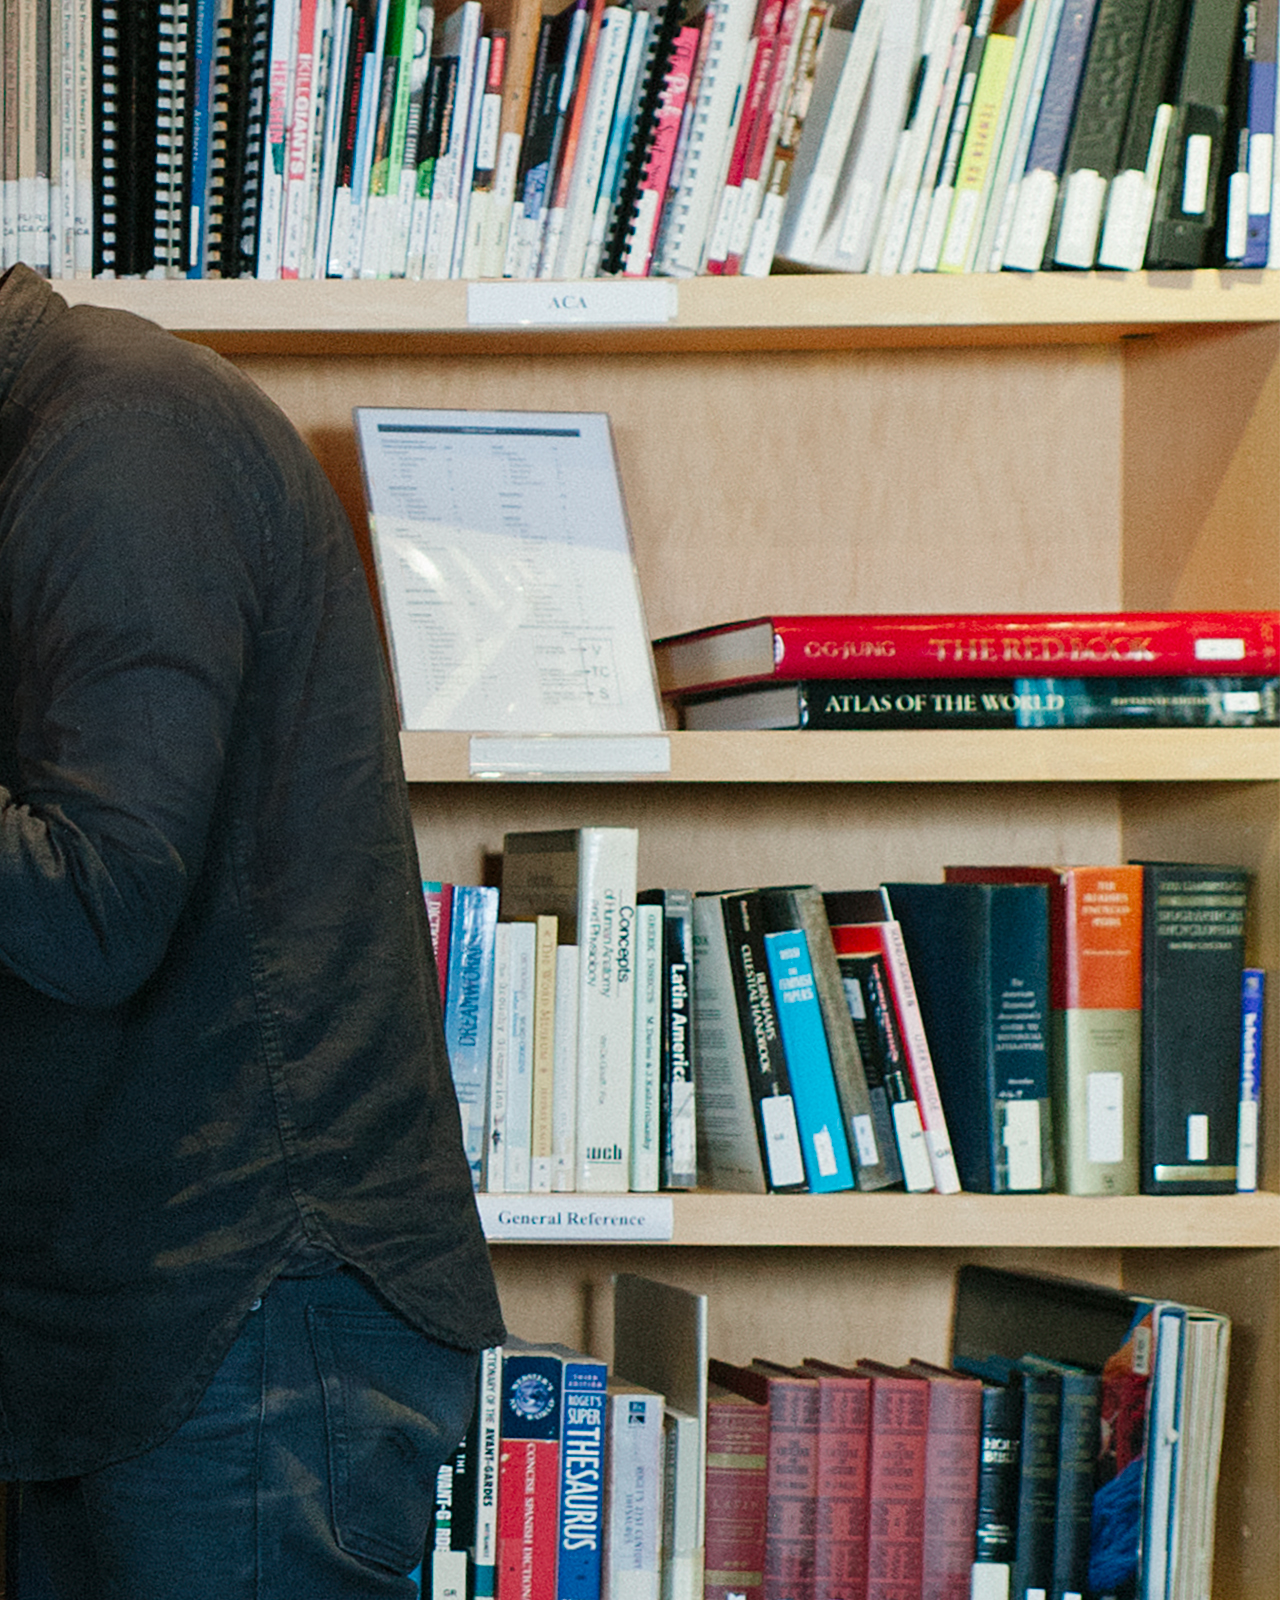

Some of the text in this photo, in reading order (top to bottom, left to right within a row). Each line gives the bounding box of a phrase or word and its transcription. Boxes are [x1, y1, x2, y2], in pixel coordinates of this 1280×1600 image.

[78, 14, 87, 63] Proceedings
[79, 64, 87, 73] of
[79, 73, 87, 87] the
[78, 88, 87, 126] February
[268, 60, 288, 144] HENSHIN
[79, 128, 87, 160] Forums
[549, 295, 588, 309] ACA
[928, 637, 998, 662] THE
[1000, 638, 1063, 662] RED
[1073, 636, 1154, 662] BOOK
[824, 694, 893, 713] ATLAS
[896, 694, 927, 712] OF
[929, 694, 977, 712] THE
[982, 694, 1065, 712] WORLD
[599, 888, 616, 998] of Human Anatomy
[616, 905, 634, 983] Concepts
[646, 913, 656, 953] GREEK
[645, 957, 656, 1004] INSECTS
[671, 963, 688, 1010] Latin
[739, 944, 772, 1074] CELESTIAL HANDBOOK
[497, 1210, 646, 1226] General Reference
[485, 1394, 496, 1405] OF
[485, 1407, 496, 1423] THE
[567, 1393, 602, 1408] ROGET'S
[567, 1407, 601, 1426] SUPER
[455, 1454, 466, 1475] THE
[482, 1427, 495, 1508] AVANT-GARDES
[524, 1442, 536, 1495] CONCISE
[563, 1426, 601, 1551] THESAURUS
[523, 1497, 535, 1545] SPANISH
